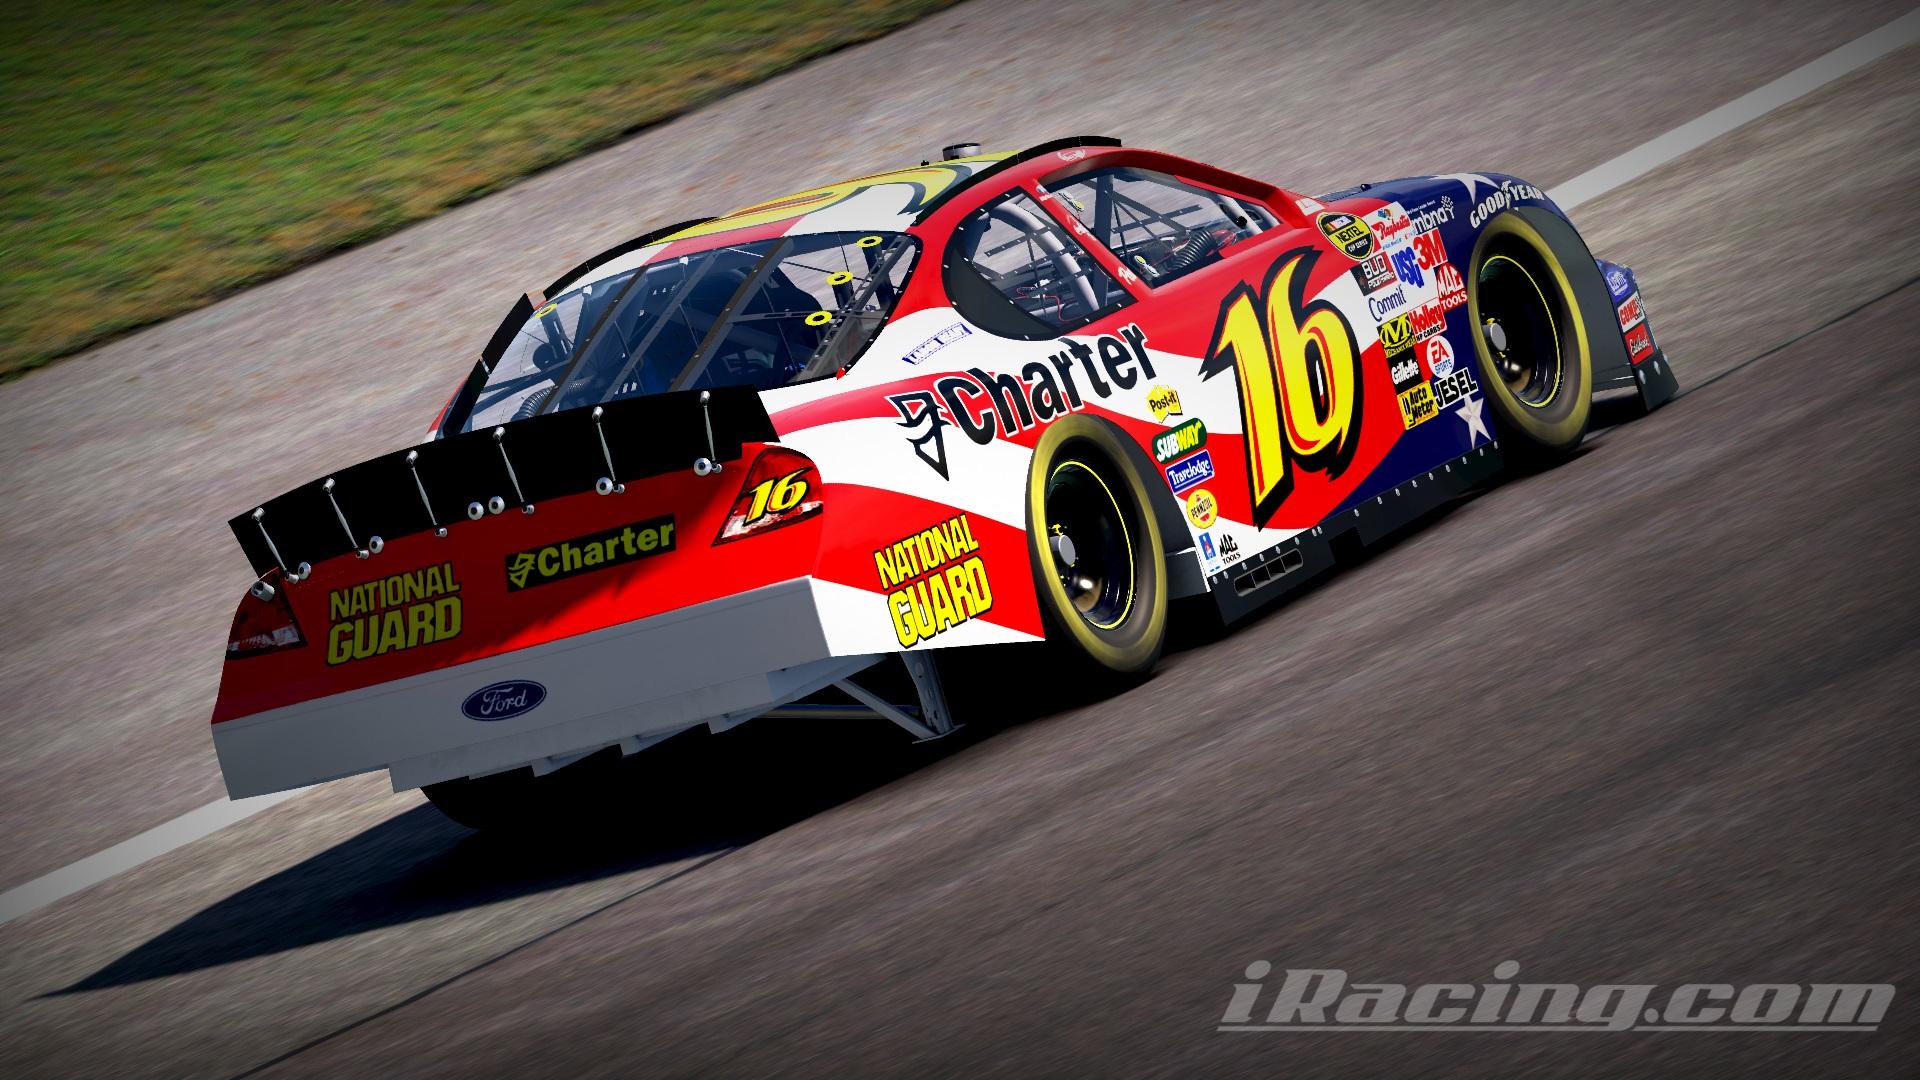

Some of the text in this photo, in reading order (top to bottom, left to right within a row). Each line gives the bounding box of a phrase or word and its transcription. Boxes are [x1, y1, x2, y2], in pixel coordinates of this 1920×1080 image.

[1335, 226, 1364, 243] NEXTEL
[1413, 207, 1448, 235] mbna
[1413, 228, 1447, 270] 3M
[1362, 255, 1387, 279] BUD
[1391, 246, 1424, 288] USG
[1438, 265, 1465, 298] MAC
[1369, 284, 1407, 322] Commit
[1441, 290, 1468, 310] TOOLS
[1409, 303, 1444, 335] Holley
[1431, 340, 1449, 364] EA
[936, 323, 1158, 446] Charter
[1391, 359, 1419, 384] Gillette
[1150, 391, 1177, 412] Post-it
[1198, 245, 1363, 532] 16
[1409, 388, 1427, 404] Auto
[1435, 369, 1477, 408] JESEL
[1412, 400, 1433, 419] Meter
[1156, 421, 1201, 462] SUBWAY
[1168, 458, 1210, 485] Travelodge
[743, 466, 814, 527] 16
[537, 523, 675, 577] Charter
[874, 514, 979, 589] NATIONAL
[1219, 534, 1238, 557] MAC
[1222, 552, 1240, 565] TOOLS
[330, 562, 461, 621] NATIONAL
[887, 556, 993, 649] GUARD
[326, 597, 463, 666] GUARD
[481, 688, 528, 717] Ford
